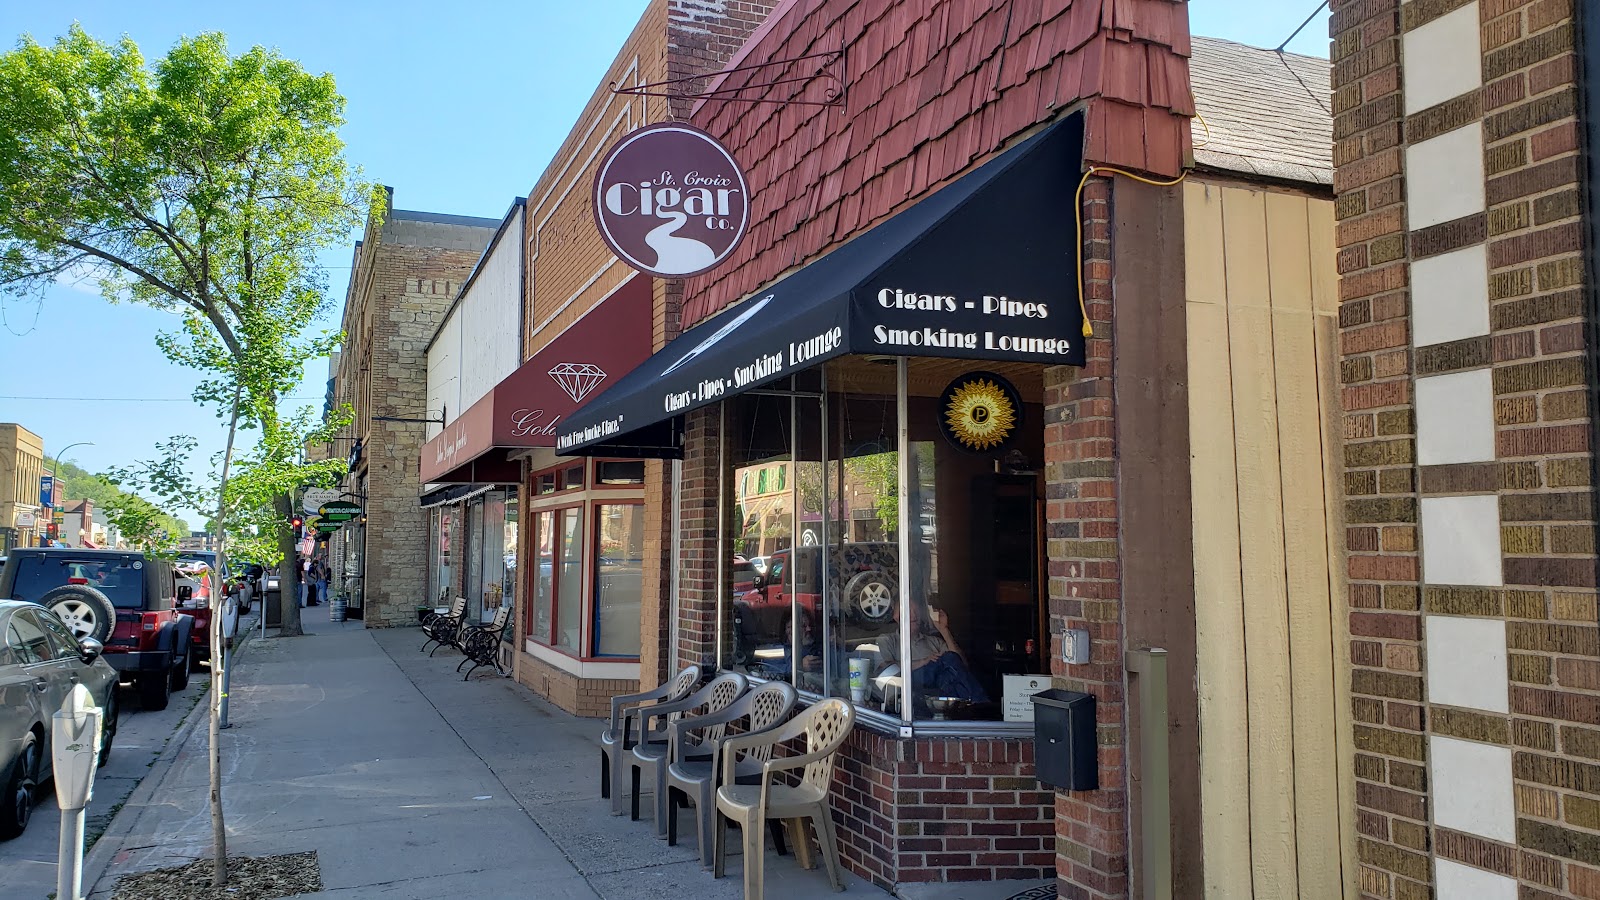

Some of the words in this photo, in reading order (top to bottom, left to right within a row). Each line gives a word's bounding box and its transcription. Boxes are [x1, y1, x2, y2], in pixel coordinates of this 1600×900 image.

[653, 170, 676, 186] St.
[684, 171, 731, 186] Croix
[605, 181, 740, 218] Cigar
[877, 288, 957, 312] Cigars
[982, 296, 1048, 319] Pipes
[873, 324, 977, 350] Smoking
[984, 332, 1070, 355] Lounge
[664, 390, 691, 413] Cigars
[698, 378, 725, 401] Pipes
[734, 350, 783, 389] Smoking
[789, 326, 842, 367] Lounge
[975, 407, 987, 421] P
[557, 437, 561, 449] A
[561, 433, 573, 448] Work
[573, 431, 584, 445] Free
[584, 424, 601, 442] Smoke
